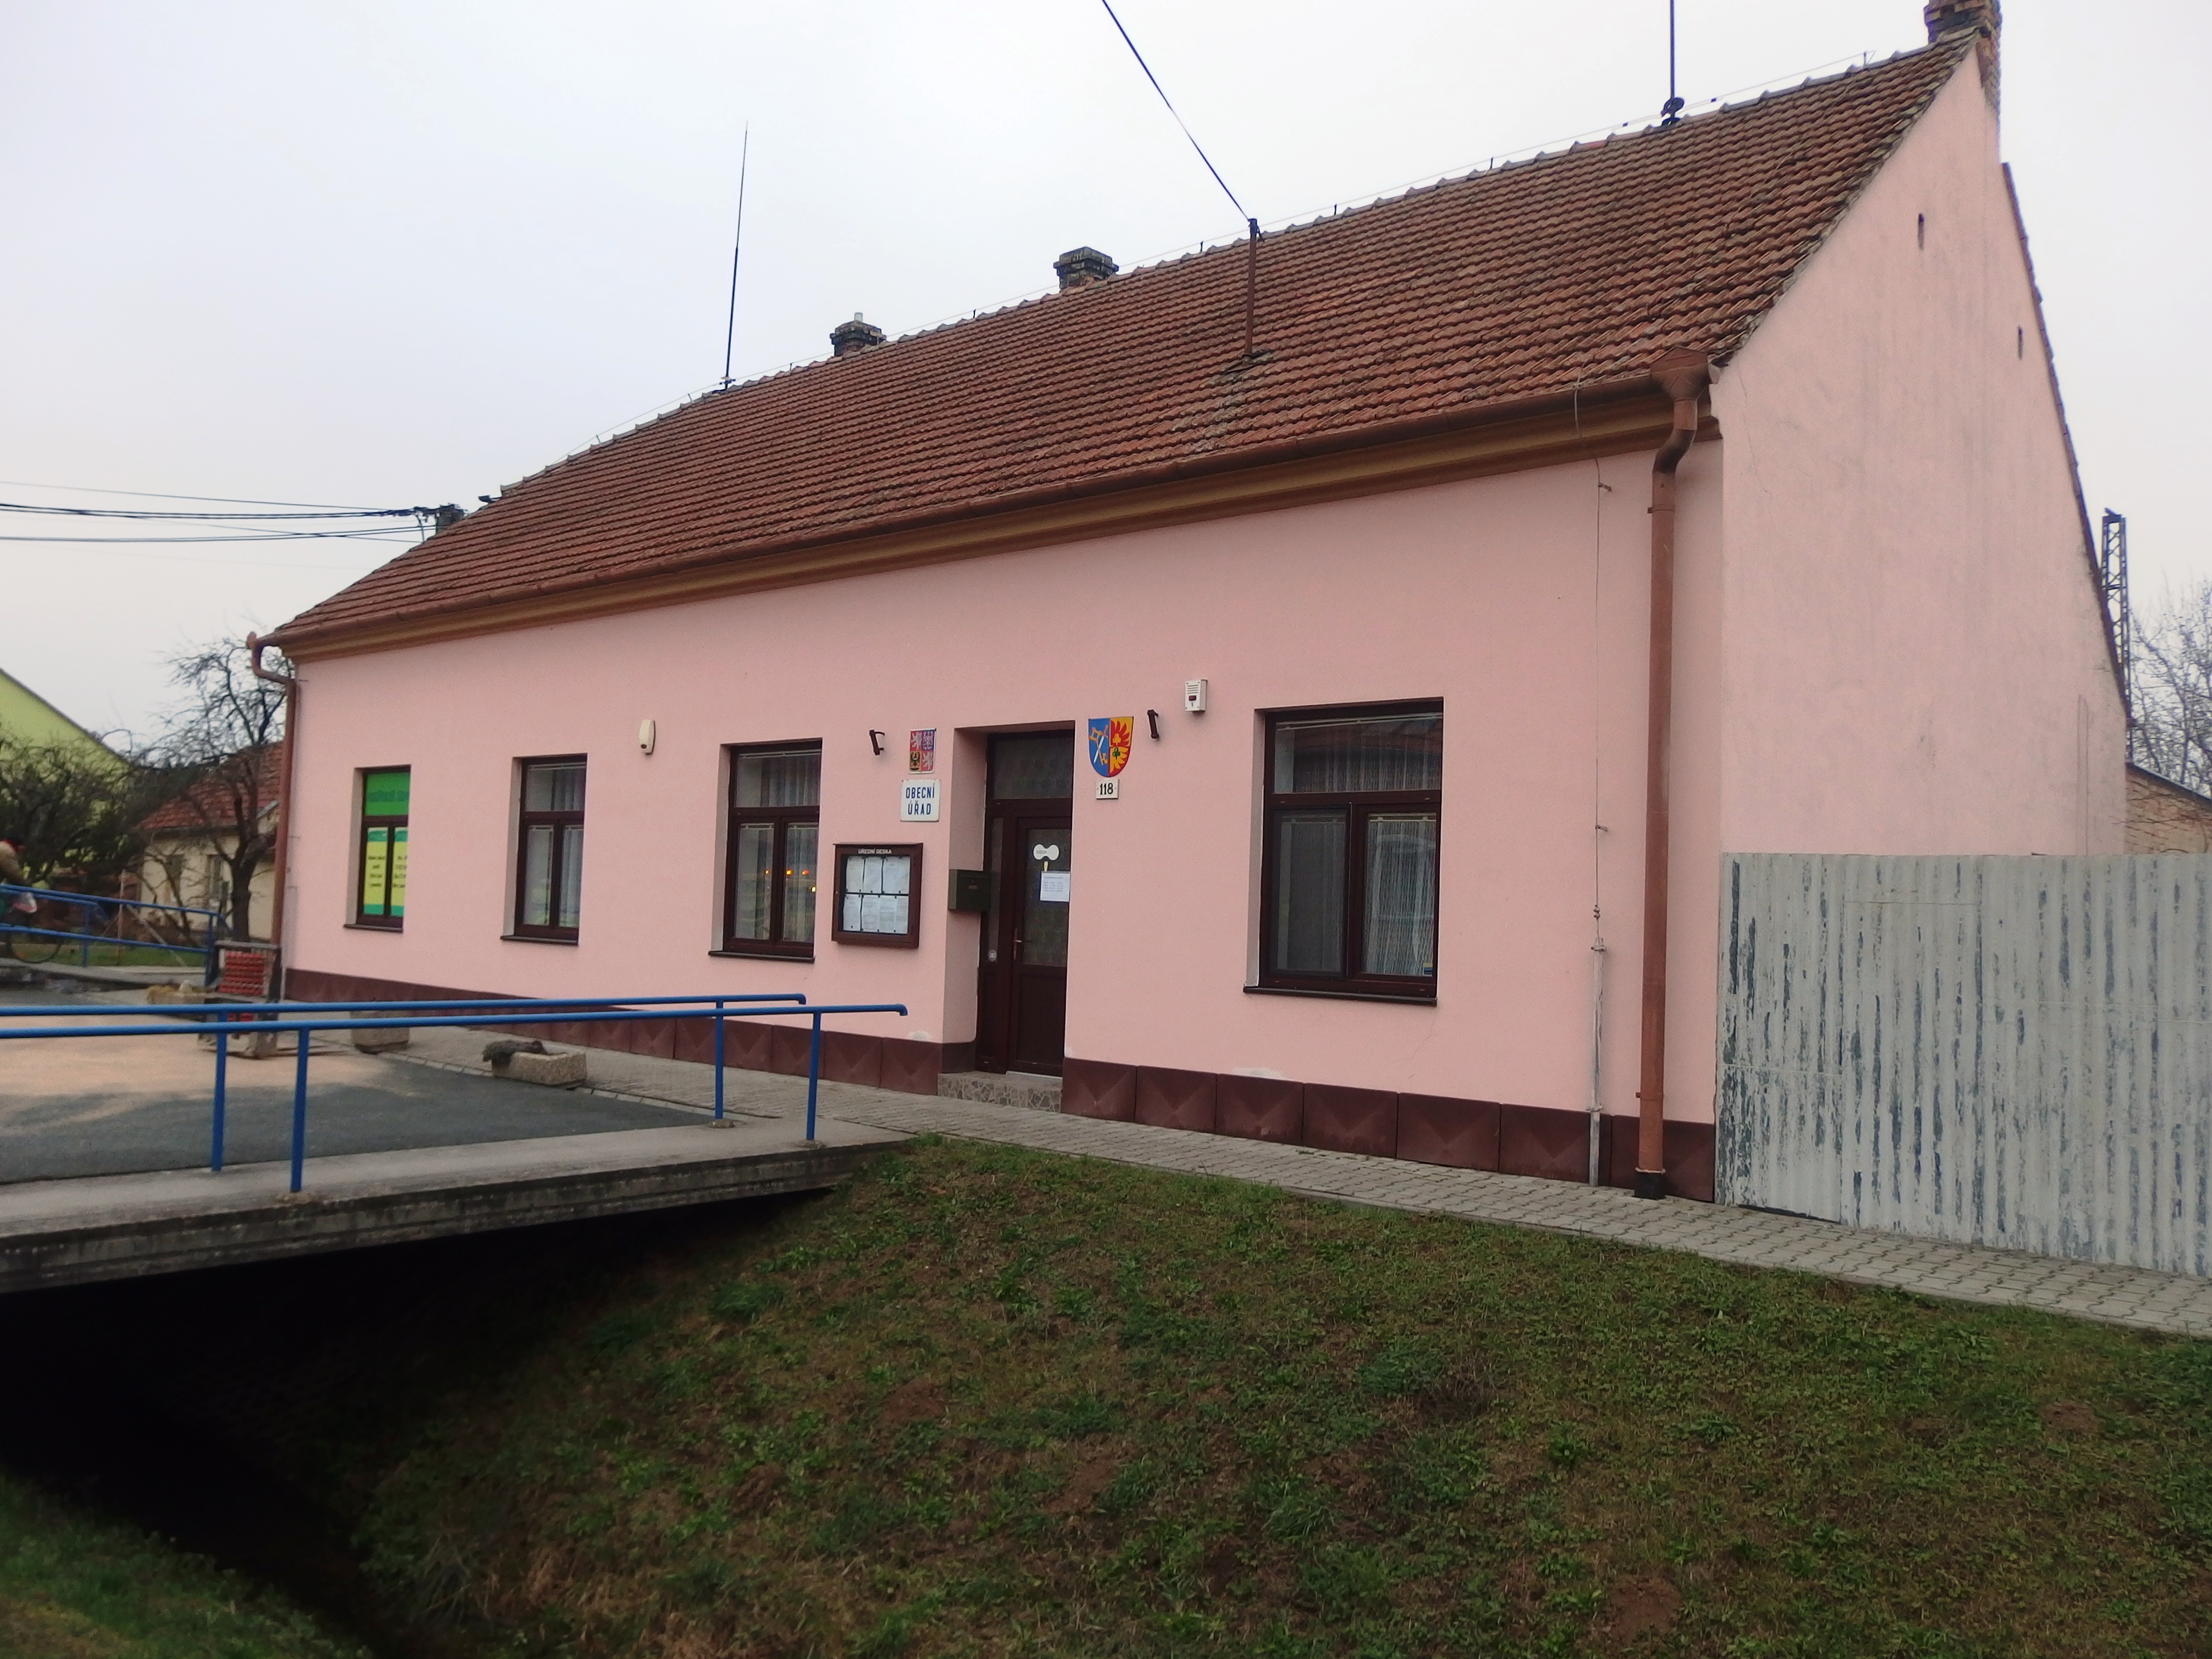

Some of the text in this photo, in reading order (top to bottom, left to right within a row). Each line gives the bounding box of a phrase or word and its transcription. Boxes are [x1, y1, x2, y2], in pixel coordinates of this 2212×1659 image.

[906, 783, 935, 798] OBECNÍ
[1100, 783, 1113, 795] 118
[908, 800, 931, 815] ÚŘAD
